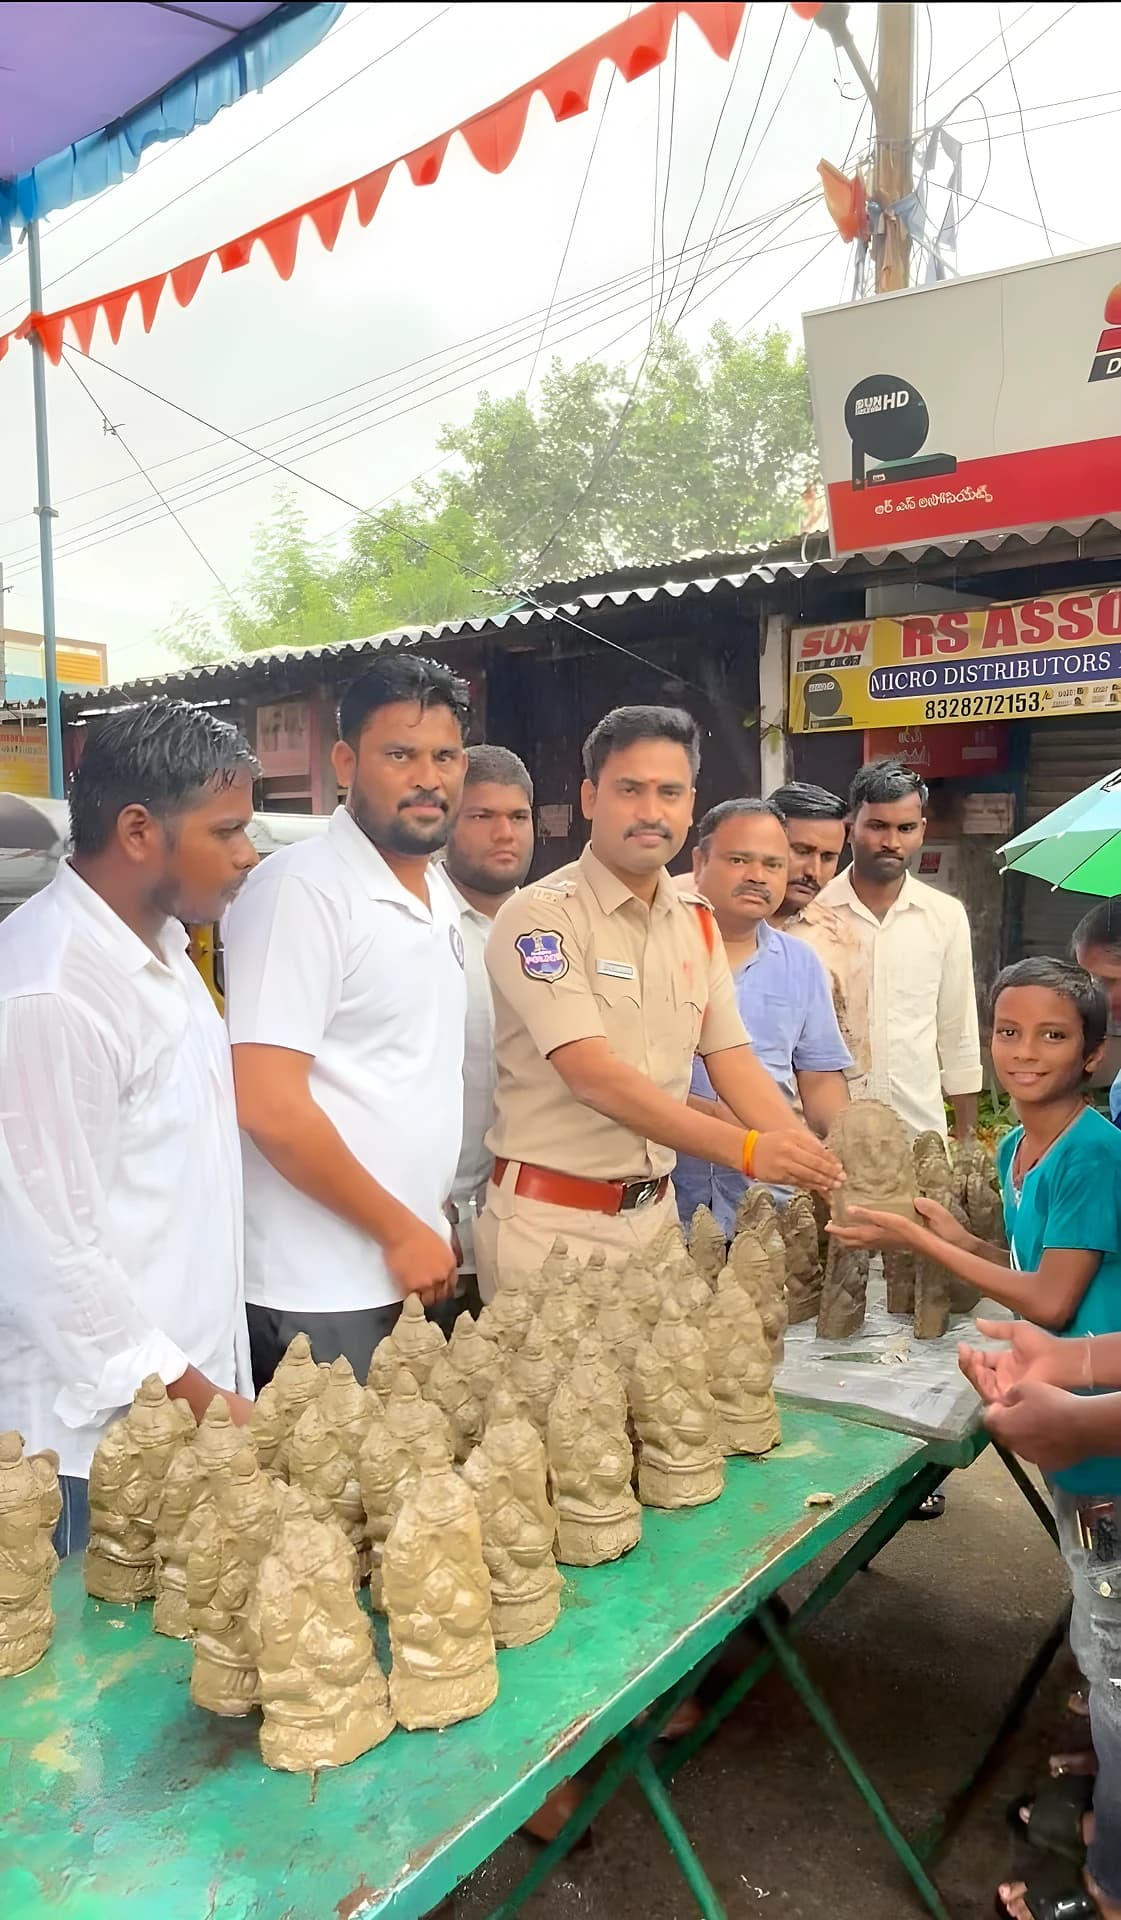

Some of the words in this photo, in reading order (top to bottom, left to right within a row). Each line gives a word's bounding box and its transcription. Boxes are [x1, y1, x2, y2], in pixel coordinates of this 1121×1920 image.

[801, 624, 872, 658] SUN
[902, 612, 969, 658] RS
[982, 590, 1121, 649] ASSO
[870, 668, 938, 693] MICRO
[943, 651, 1111, 685] DISTRIBUTORS
